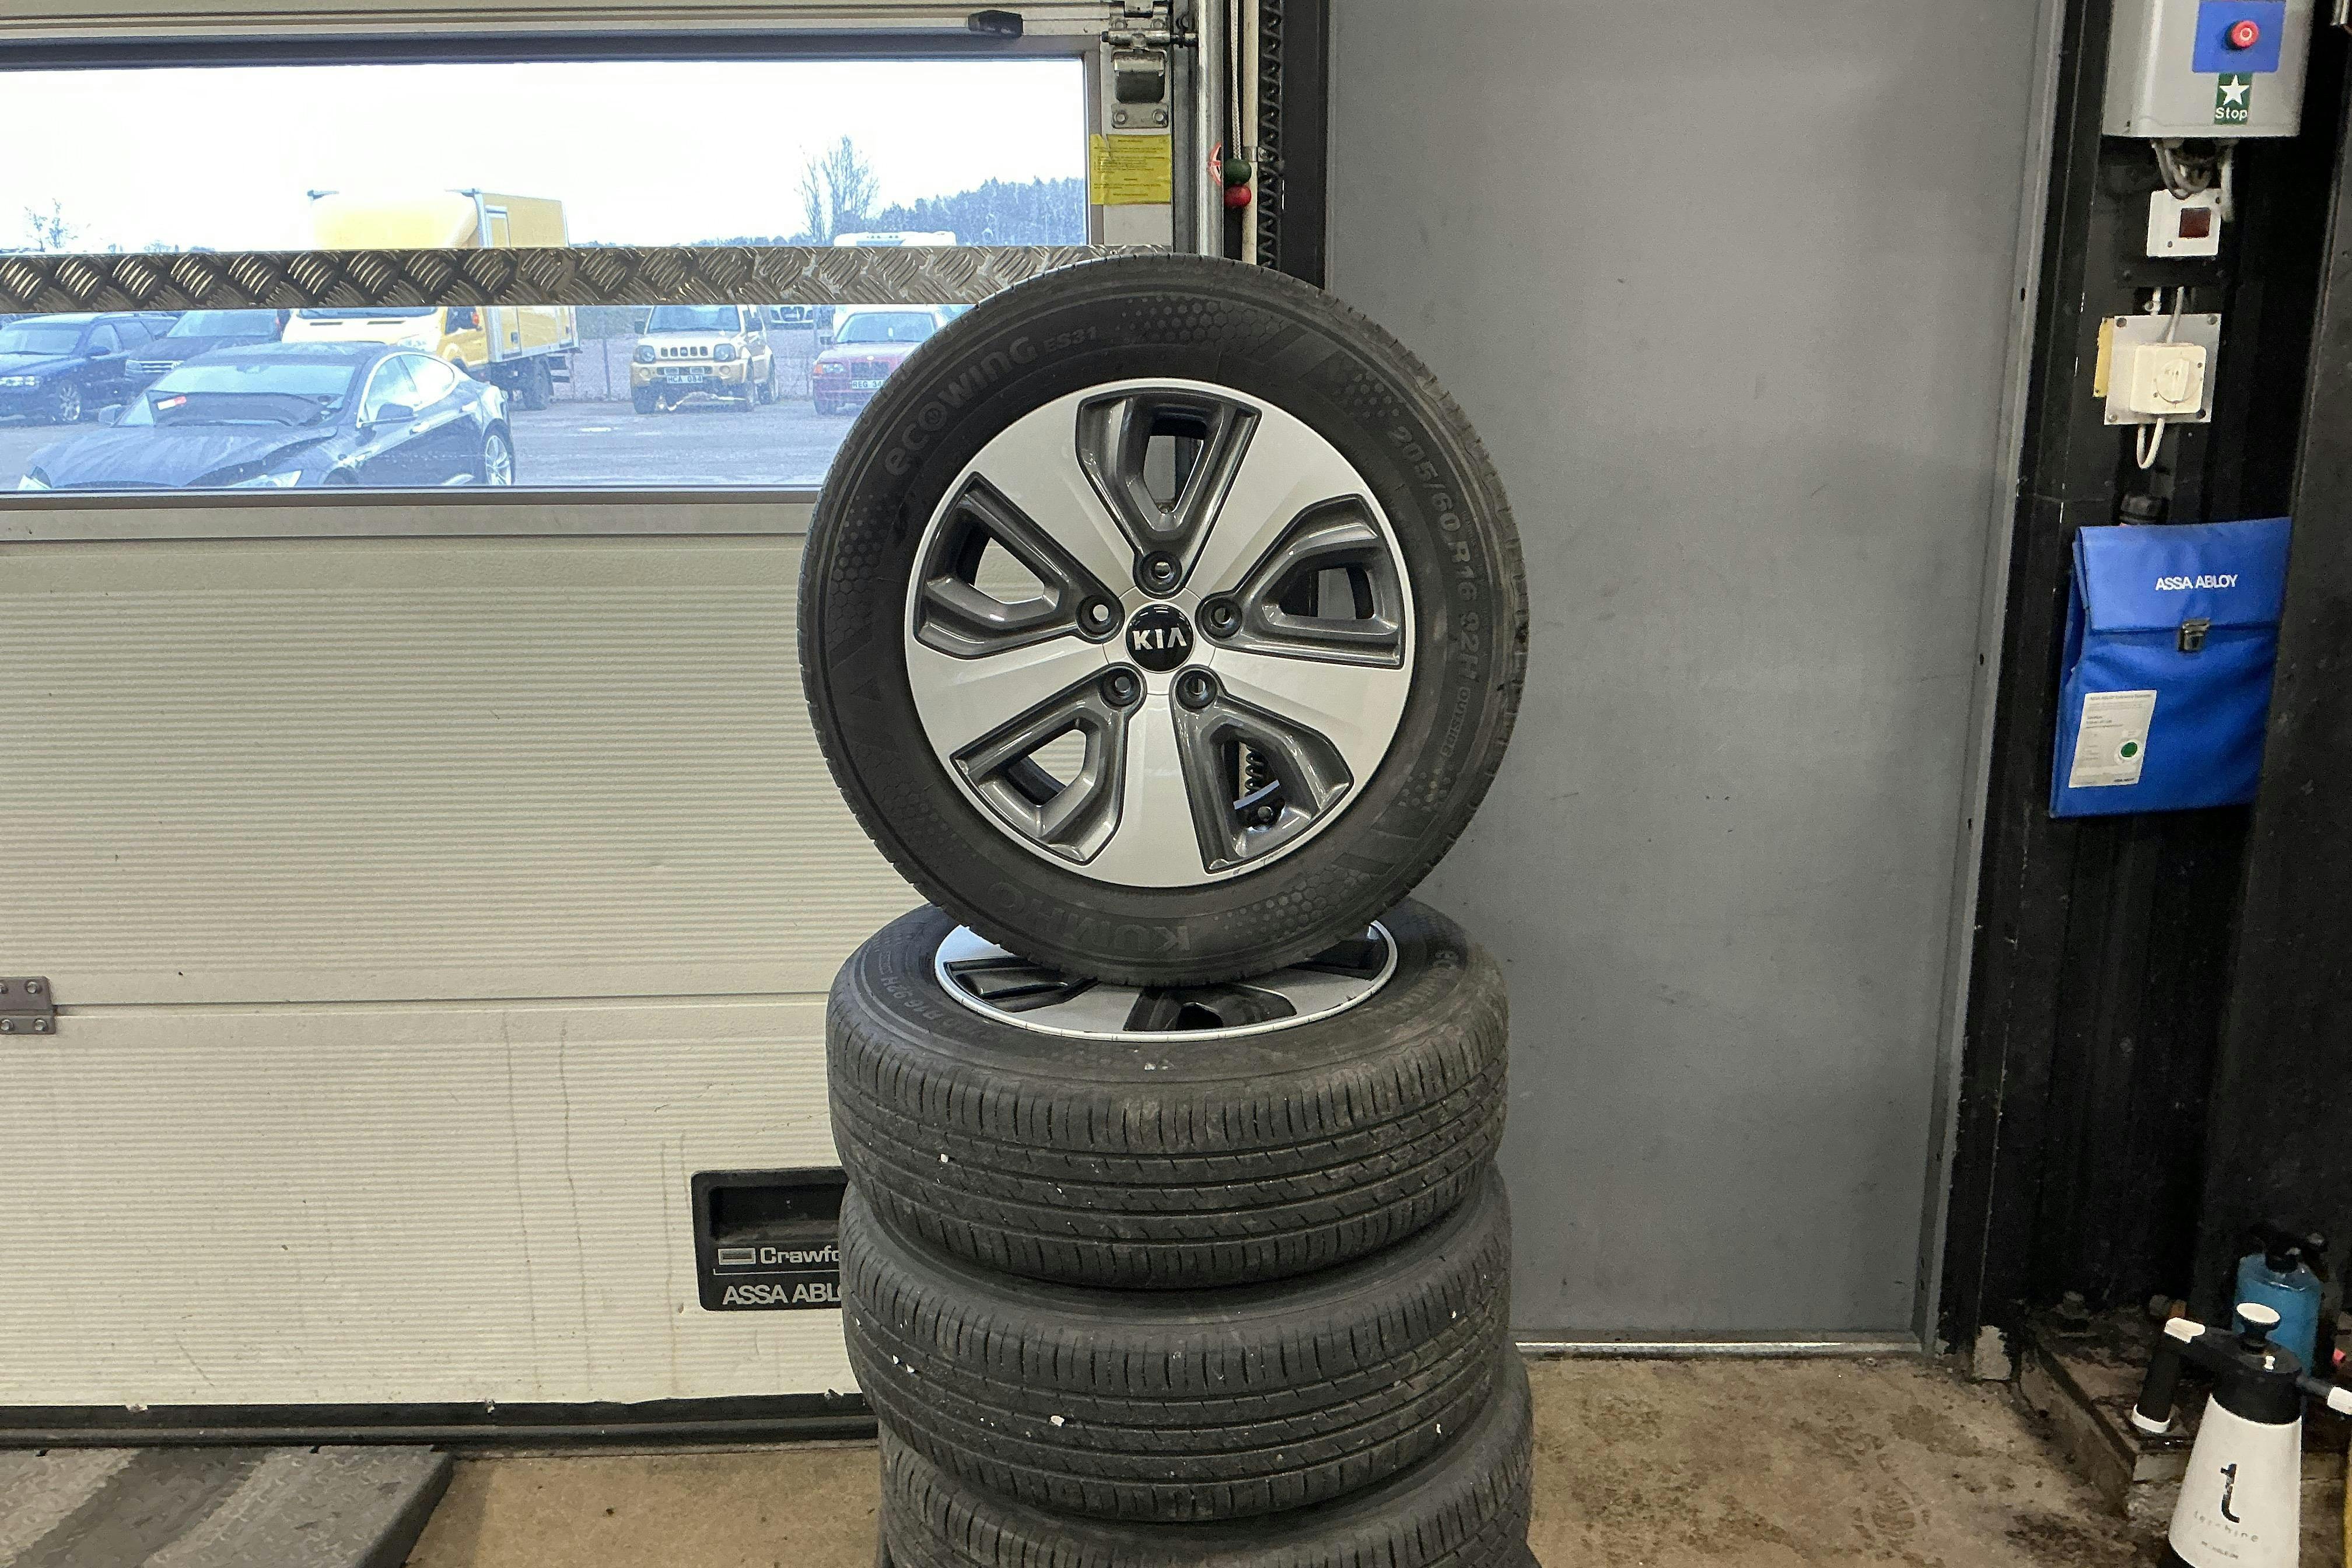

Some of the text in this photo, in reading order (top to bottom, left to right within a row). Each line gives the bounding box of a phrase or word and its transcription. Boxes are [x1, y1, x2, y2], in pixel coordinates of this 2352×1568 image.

[2215, 107, 2248, 121] Stop
[1390, 425, 1462, 534] 205/60
[1451, 539, 1478, 603] R16
[2155, 574, 2239, 591] ASSA ABLOY
[1132, 627, 1187, 650] KIA
[760, 1245, 839, 1265] Crawfo
[722, 1282, 841, 1305] ASSA ABL
